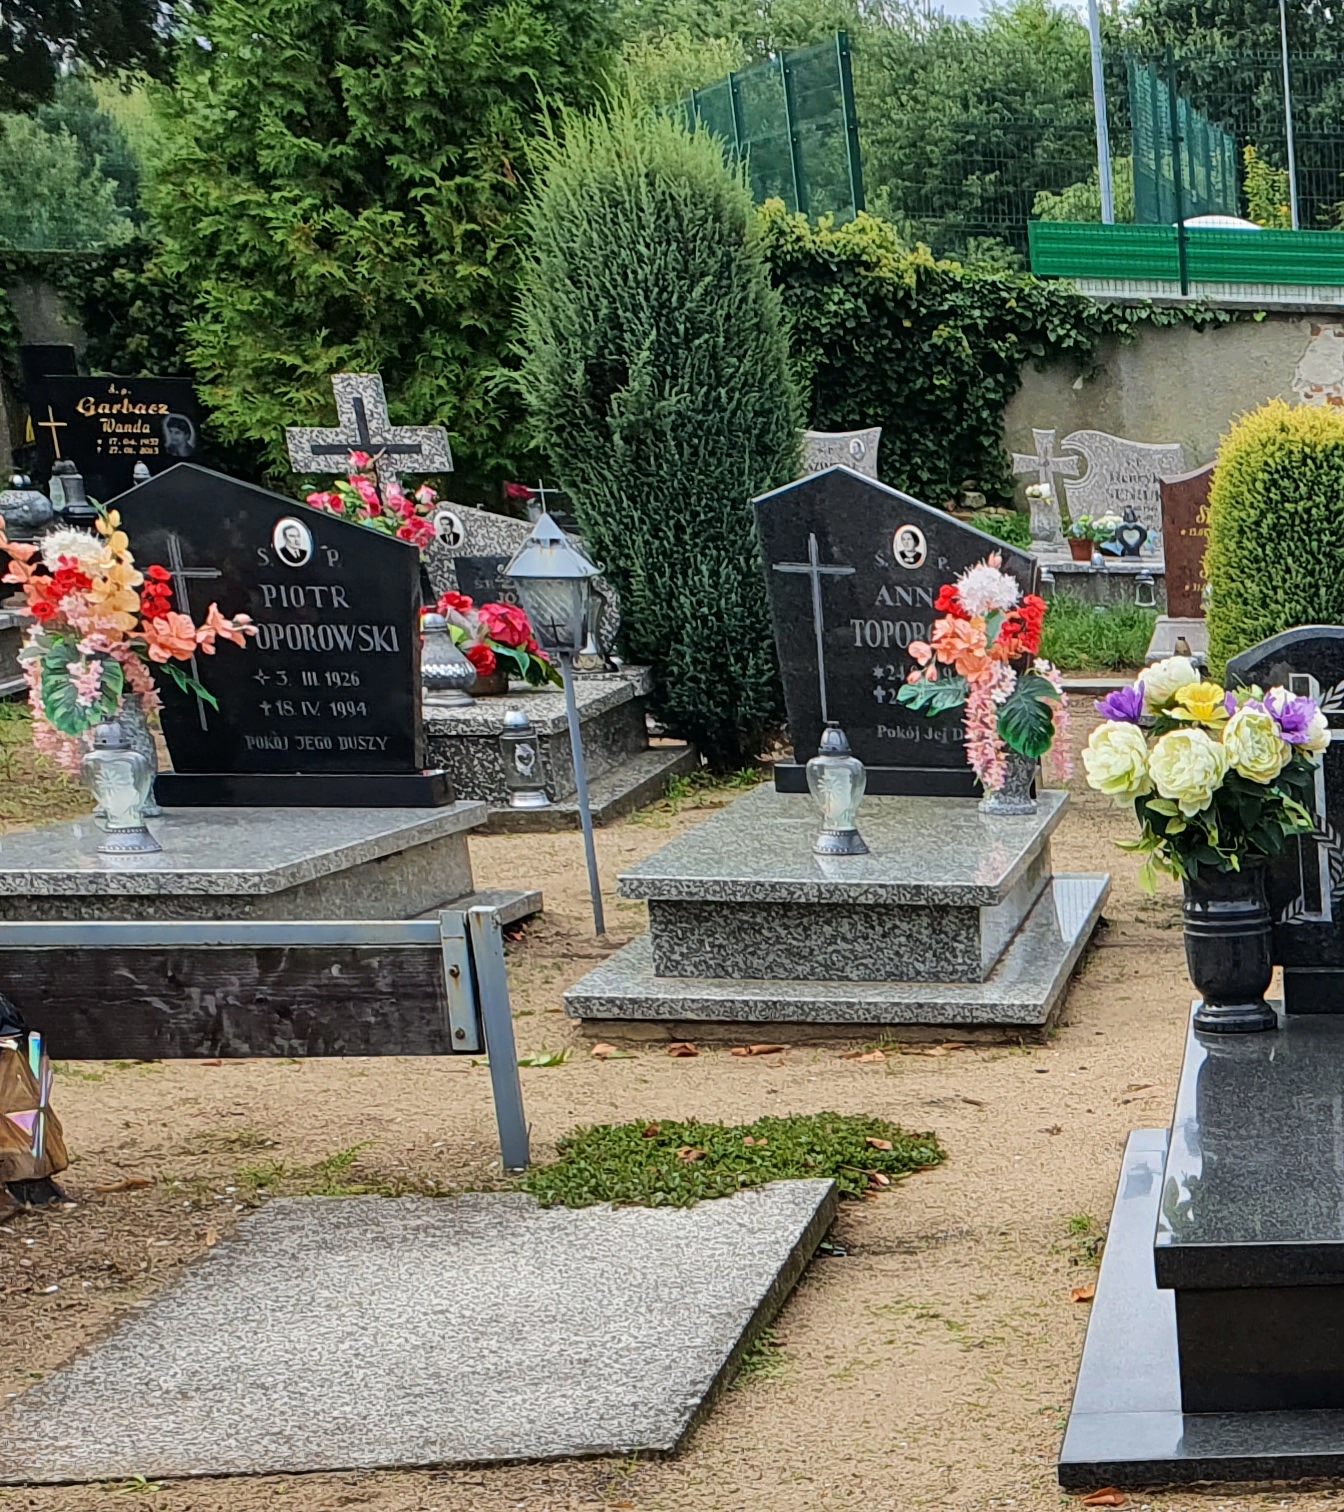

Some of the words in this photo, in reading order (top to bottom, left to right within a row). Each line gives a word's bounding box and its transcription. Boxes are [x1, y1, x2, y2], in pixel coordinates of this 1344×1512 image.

[99, 419, 150, 433] Wanda
[259, 584, 350, 608] PIOTR
[875, 585, 933, 608] ANN
[256, 624, 400, 652] OPOROWSKI
[850, 619, 933, 648] TOPOR
[325, 671, 360, 688] 1926
[245, 732, 289, 750] POKÓJ
[296, 735, 332, 750] JEGO
[339, 736, 388, 750] DUSZY
[877, 725, 920, 742] Pokój
[923, 727, 947, 743] Jej
